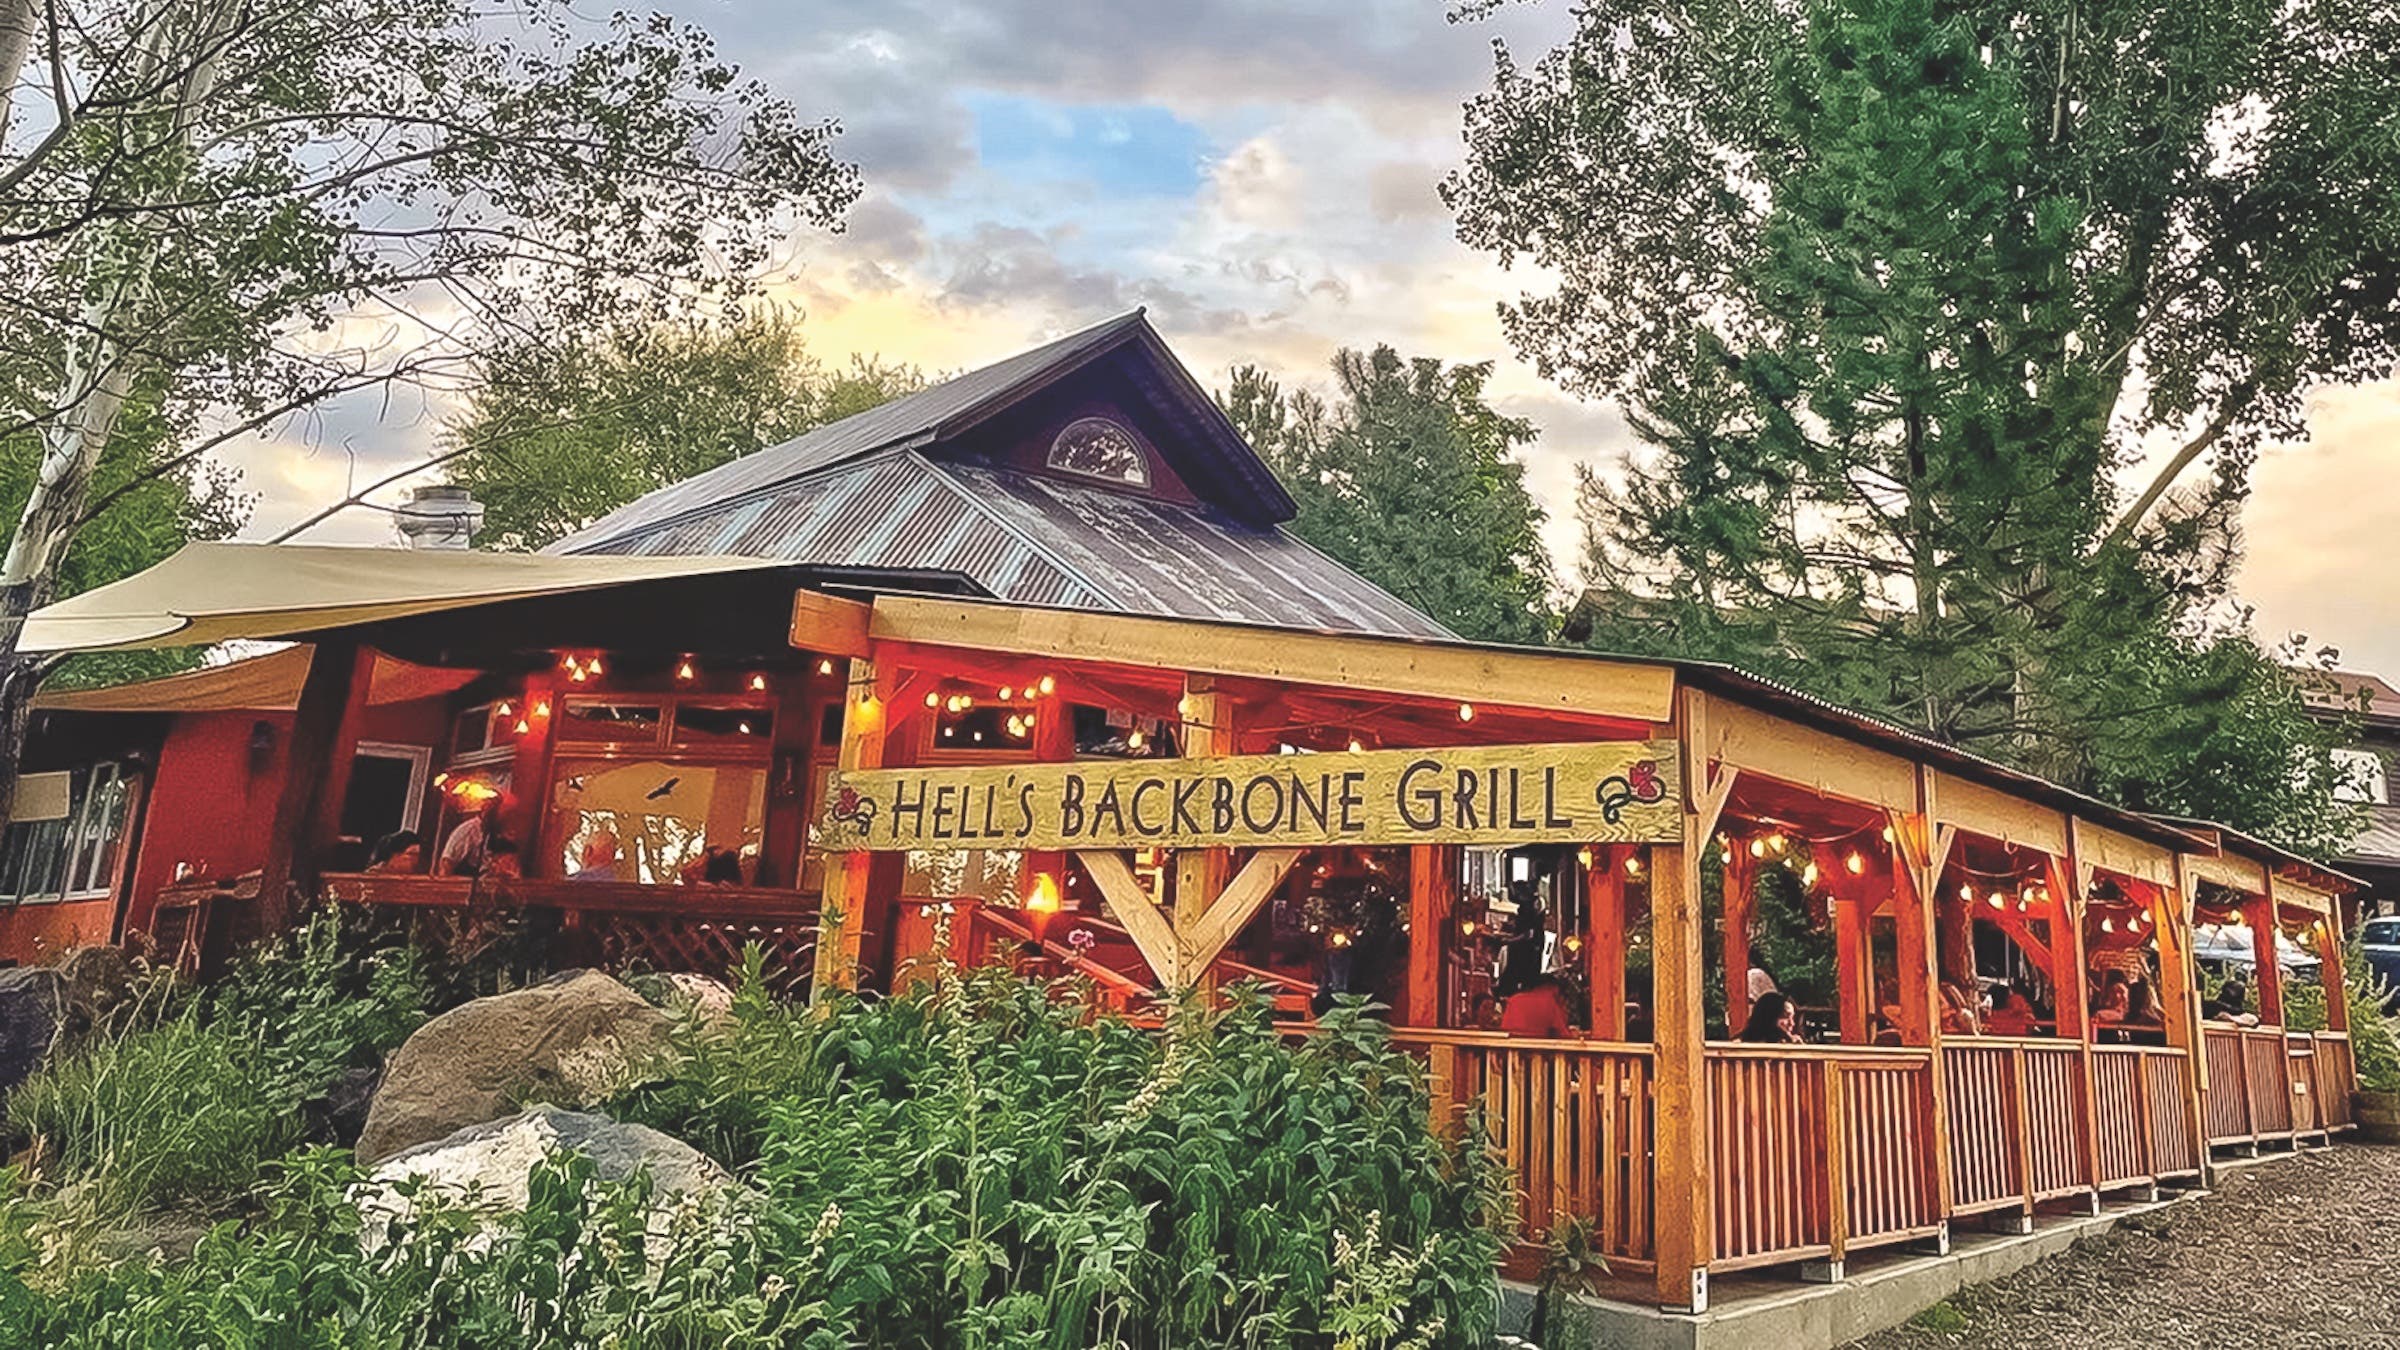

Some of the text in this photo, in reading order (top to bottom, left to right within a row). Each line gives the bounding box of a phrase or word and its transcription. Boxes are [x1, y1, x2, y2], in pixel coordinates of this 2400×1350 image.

[891, 759, 1573, 839] HELL'S BACKBONE GRILL
